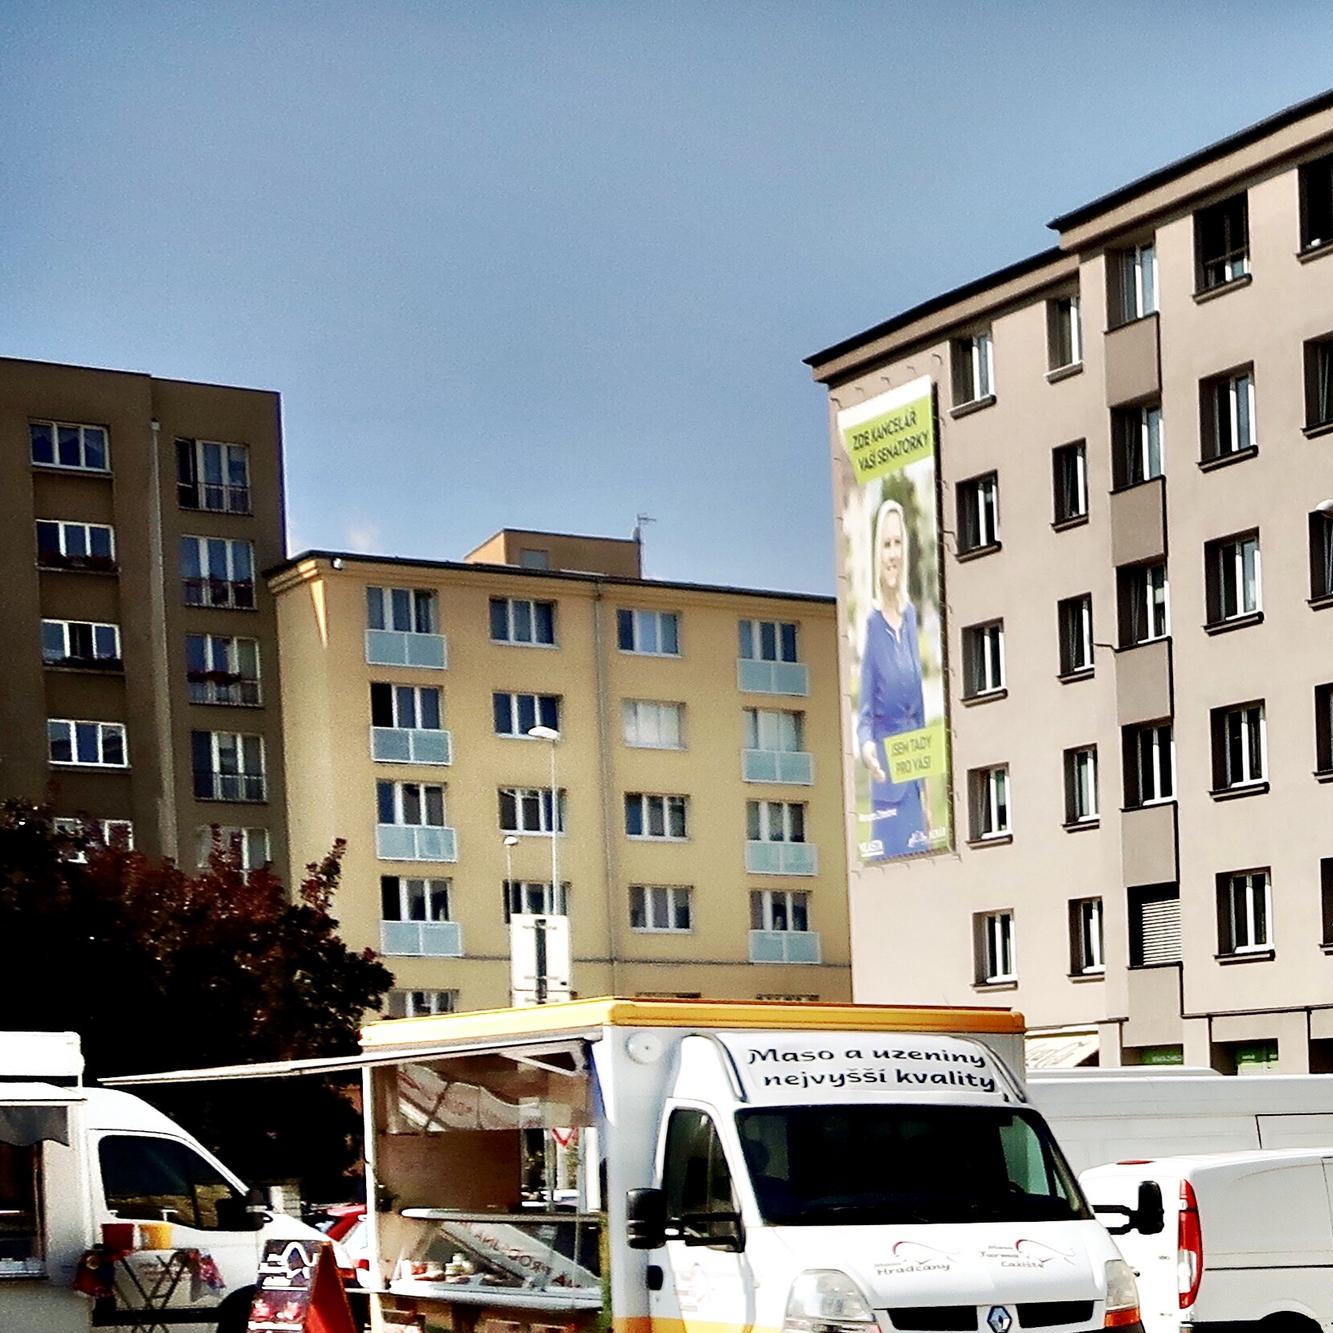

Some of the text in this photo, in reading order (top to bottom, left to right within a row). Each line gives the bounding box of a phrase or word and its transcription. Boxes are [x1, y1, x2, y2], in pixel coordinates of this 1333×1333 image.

[749, 1048, 986, 1068] Maso a uzeniny
[764, 1067, 995, 1092] nejvyšší kvality
